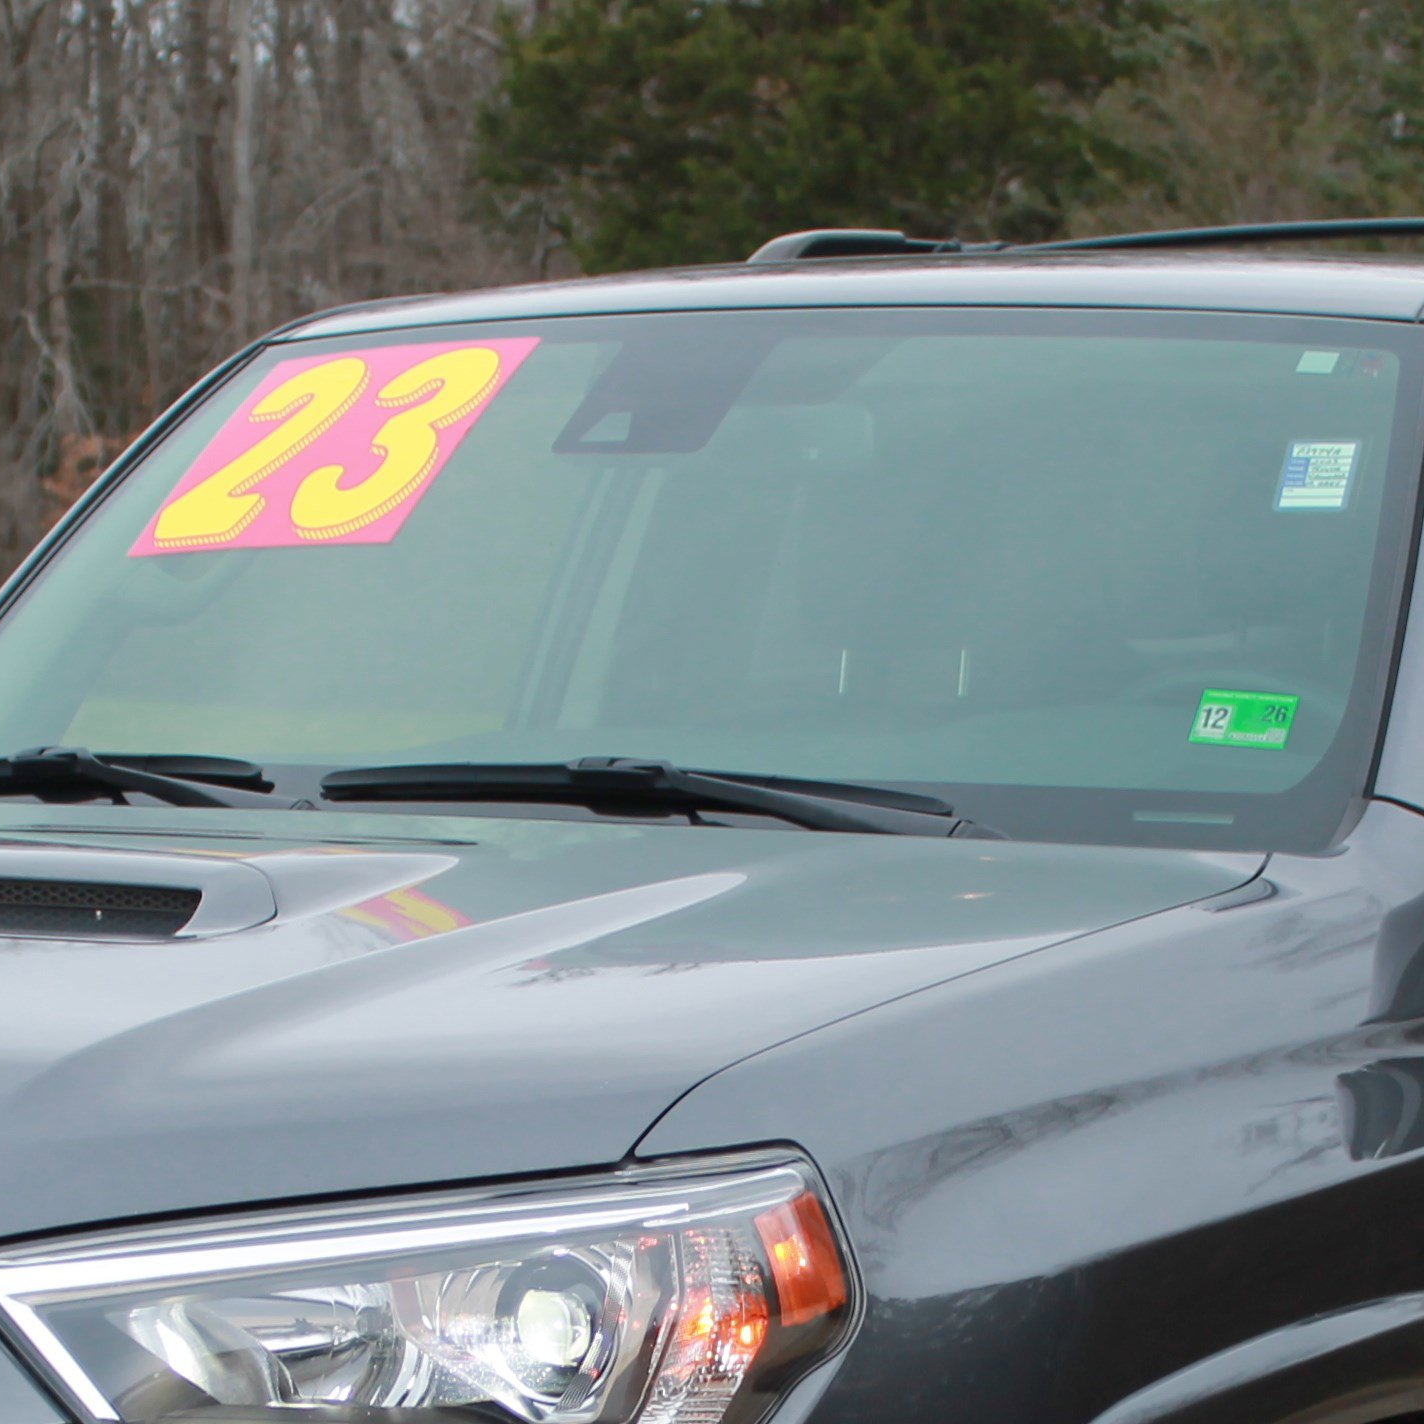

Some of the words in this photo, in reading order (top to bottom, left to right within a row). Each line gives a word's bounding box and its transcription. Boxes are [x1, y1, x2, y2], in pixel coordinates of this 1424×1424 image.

[153, 346, 501, 549] 23
[1201, 706, 1229, 730] 12
[1261, 704, 1289, 724] 26
